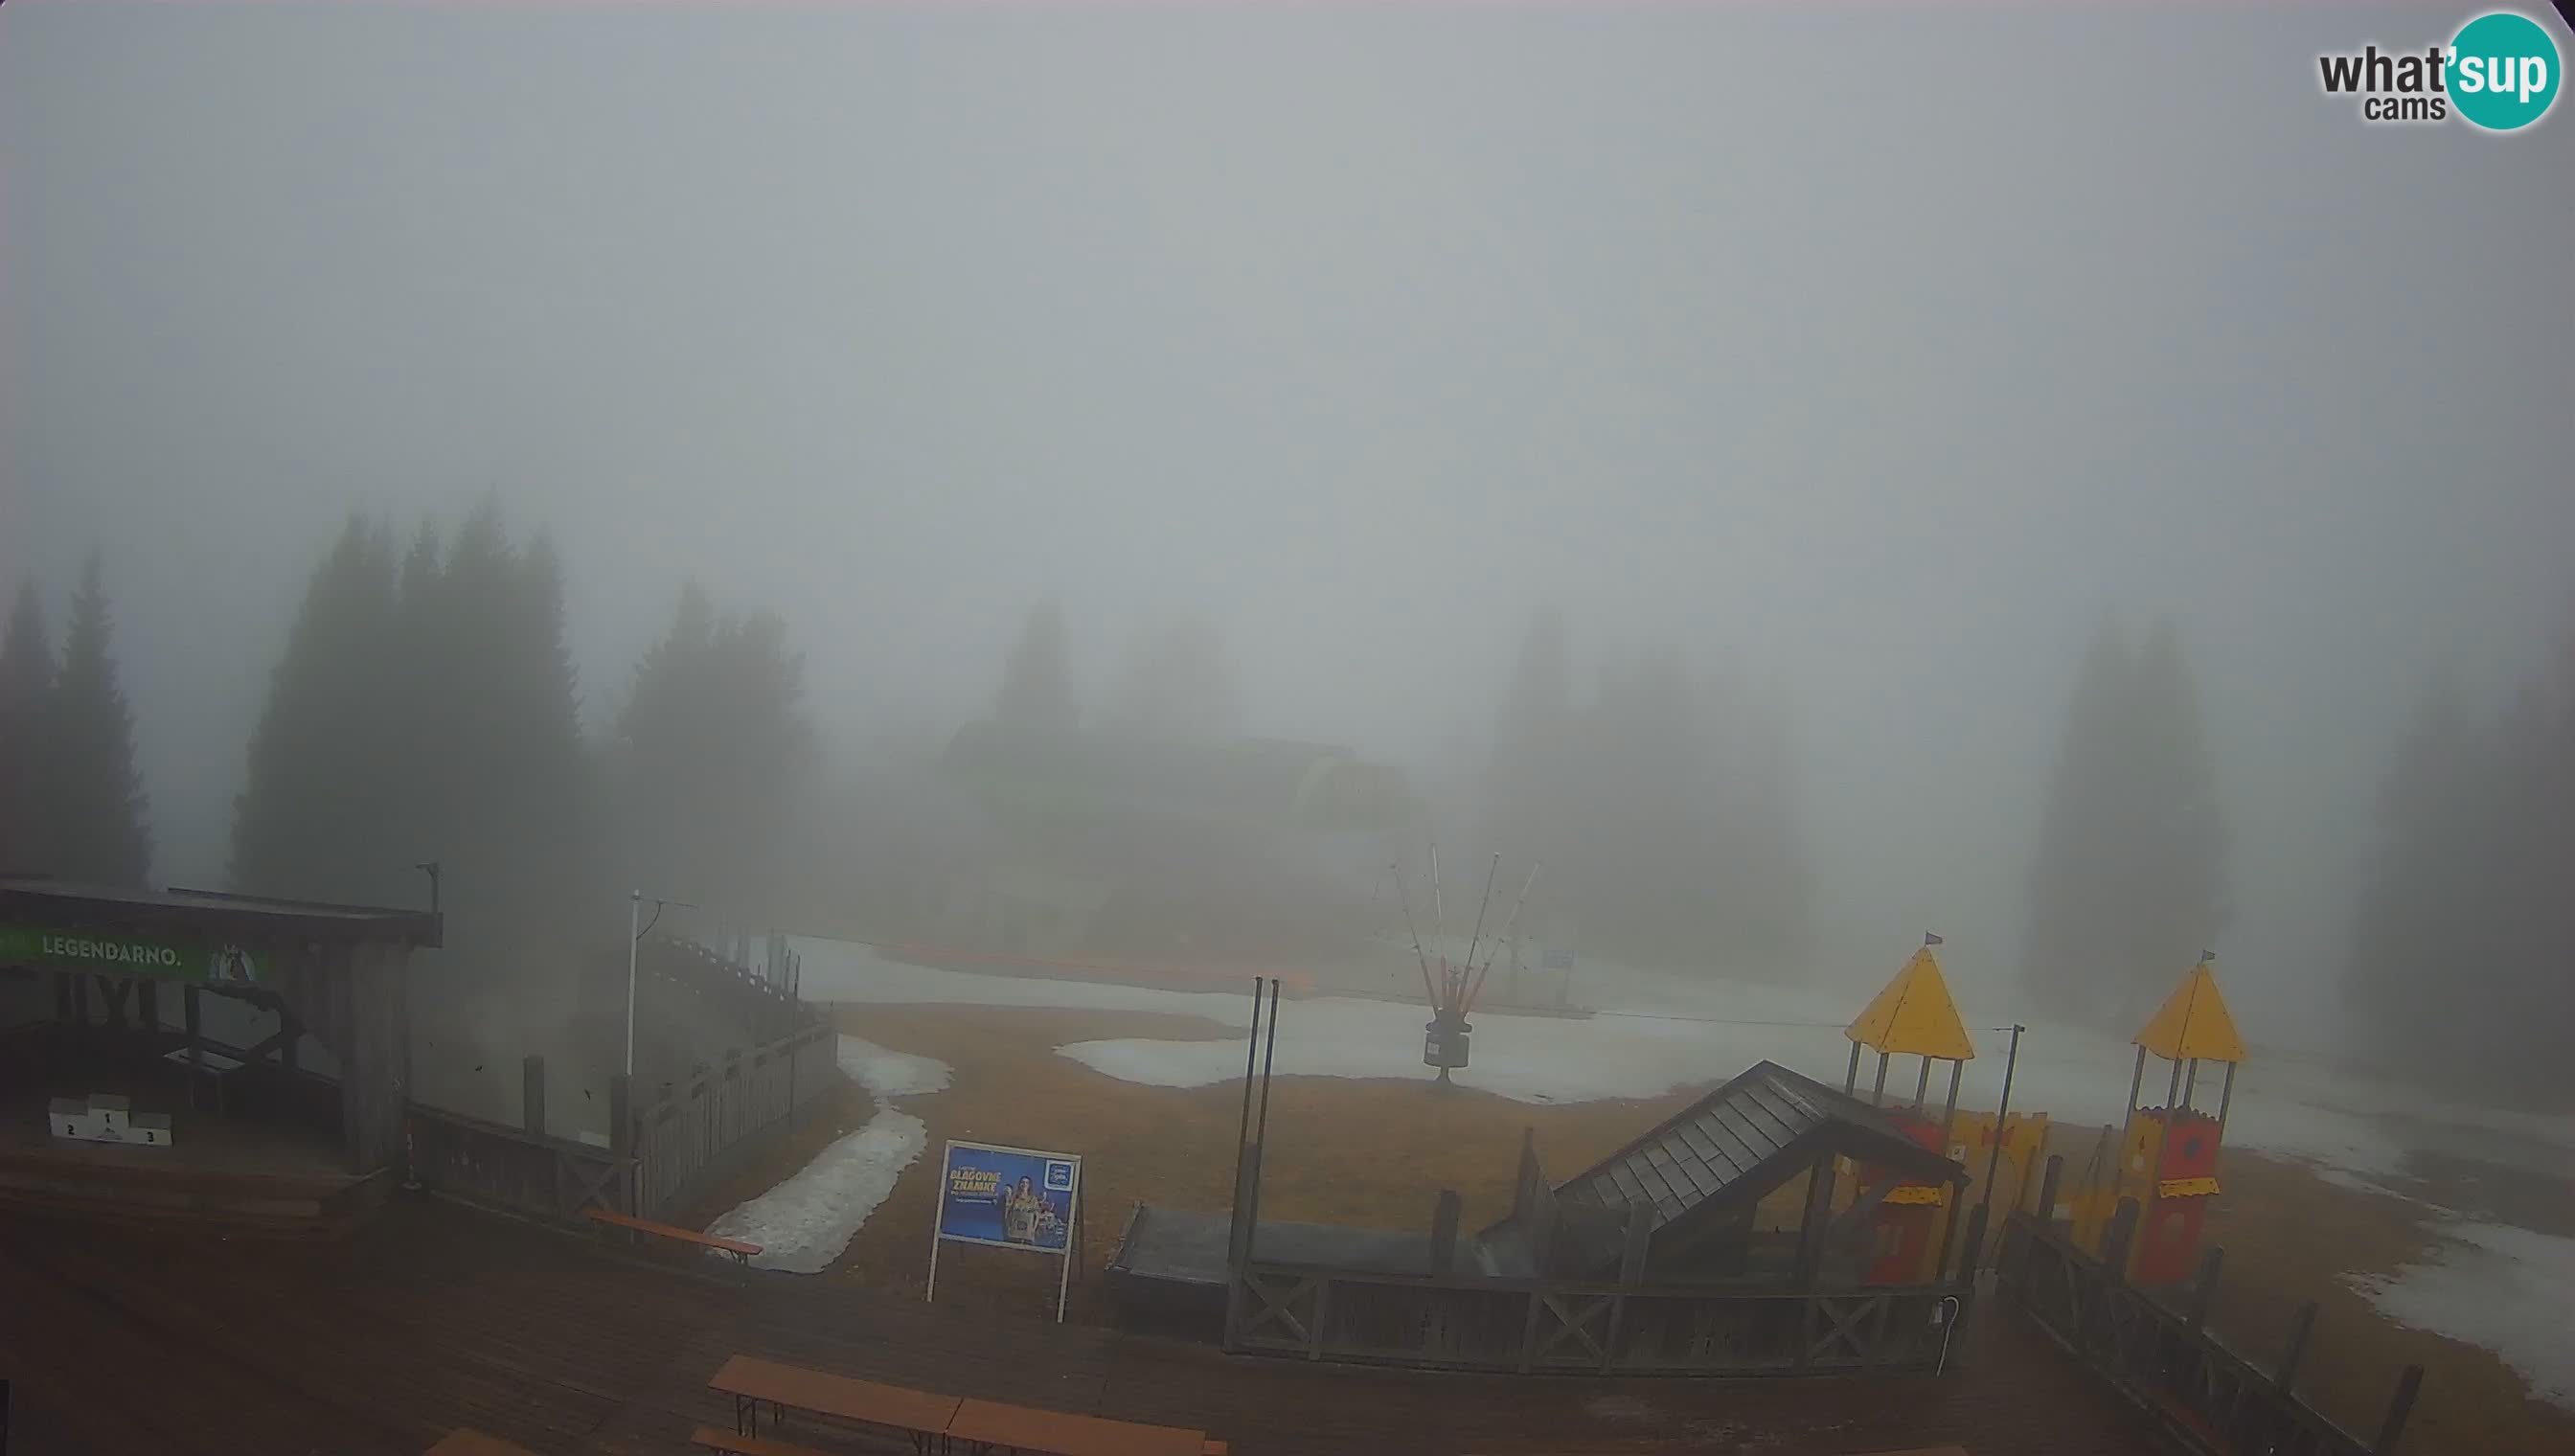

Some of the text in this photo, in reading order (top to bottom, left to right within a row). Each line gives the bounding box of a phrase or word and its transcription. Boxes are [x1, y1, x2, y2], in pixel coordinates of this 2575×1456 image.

[42, 935, 182, 967] LEGENDARNO.
[105, 1112, 110, 1124] 1
[67, 1124, 75, 1136] 2
[147, 1131, 154, 1143] 3
[949, 1170, 1002, 1182] BLAGOVNE
[953, 1180, 997, 1193] ZNAMKE
